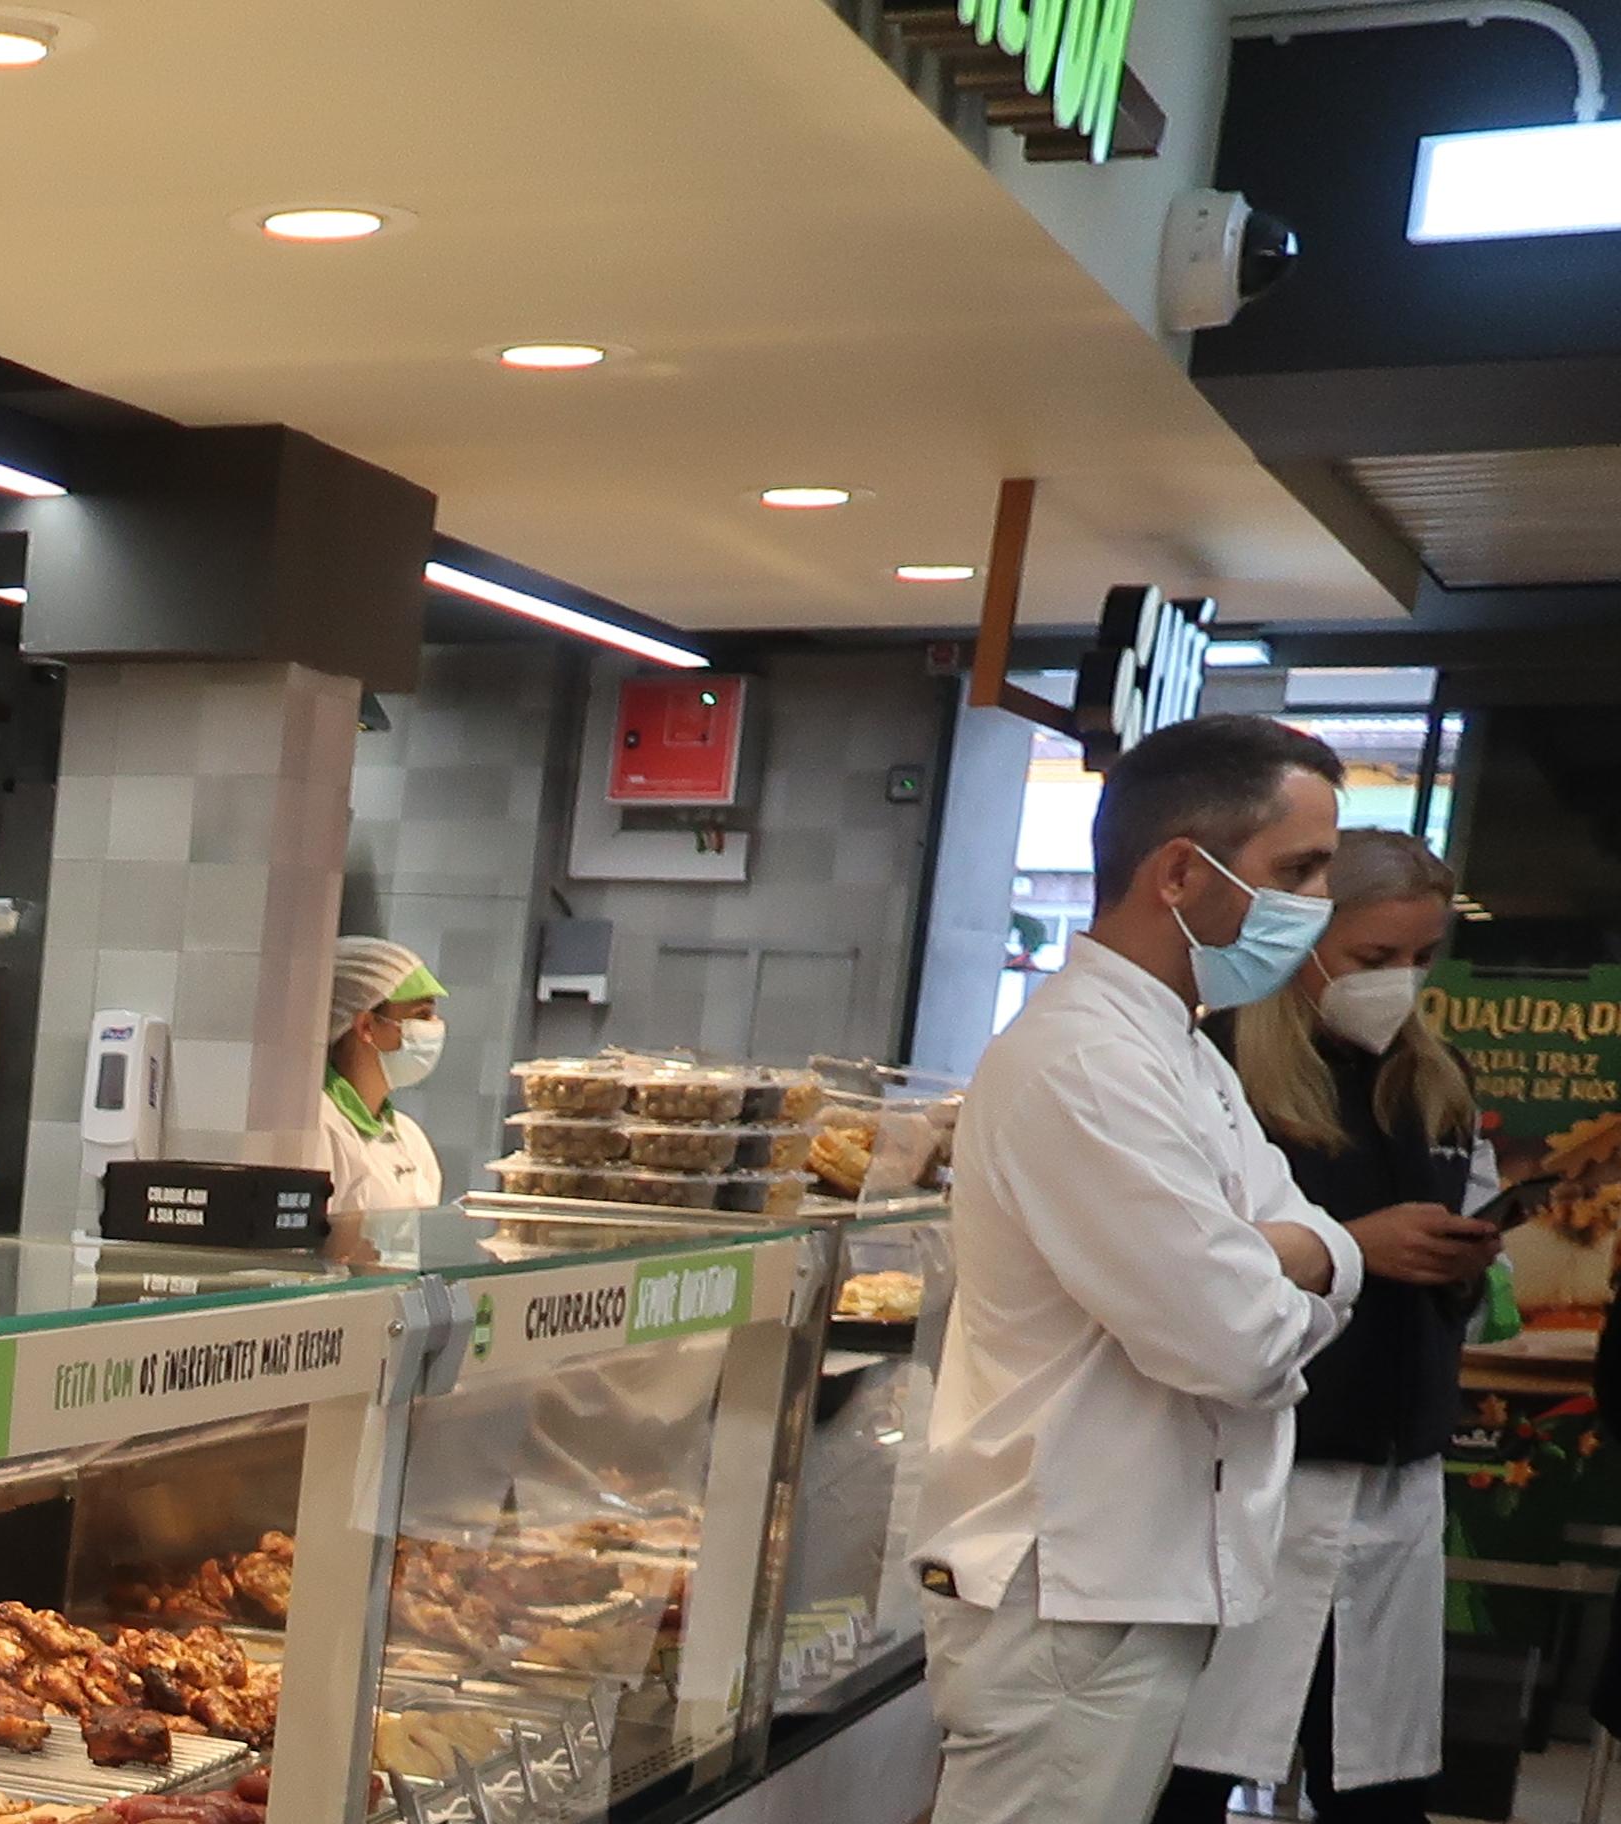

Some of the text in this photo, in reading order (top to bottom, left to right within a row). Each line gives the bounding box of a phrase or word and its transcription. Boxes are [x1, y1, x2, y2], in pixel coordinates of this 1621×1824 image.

[1418, 986, 1621, 1043] QUALIDAD
[525, 1285, 627, 1341] CHURRASCO
[102, 1357, 135, 1403] COM
[139, 1353, 157, 1397] OS
[294, 1327, 345, 1373] FRESCOS
